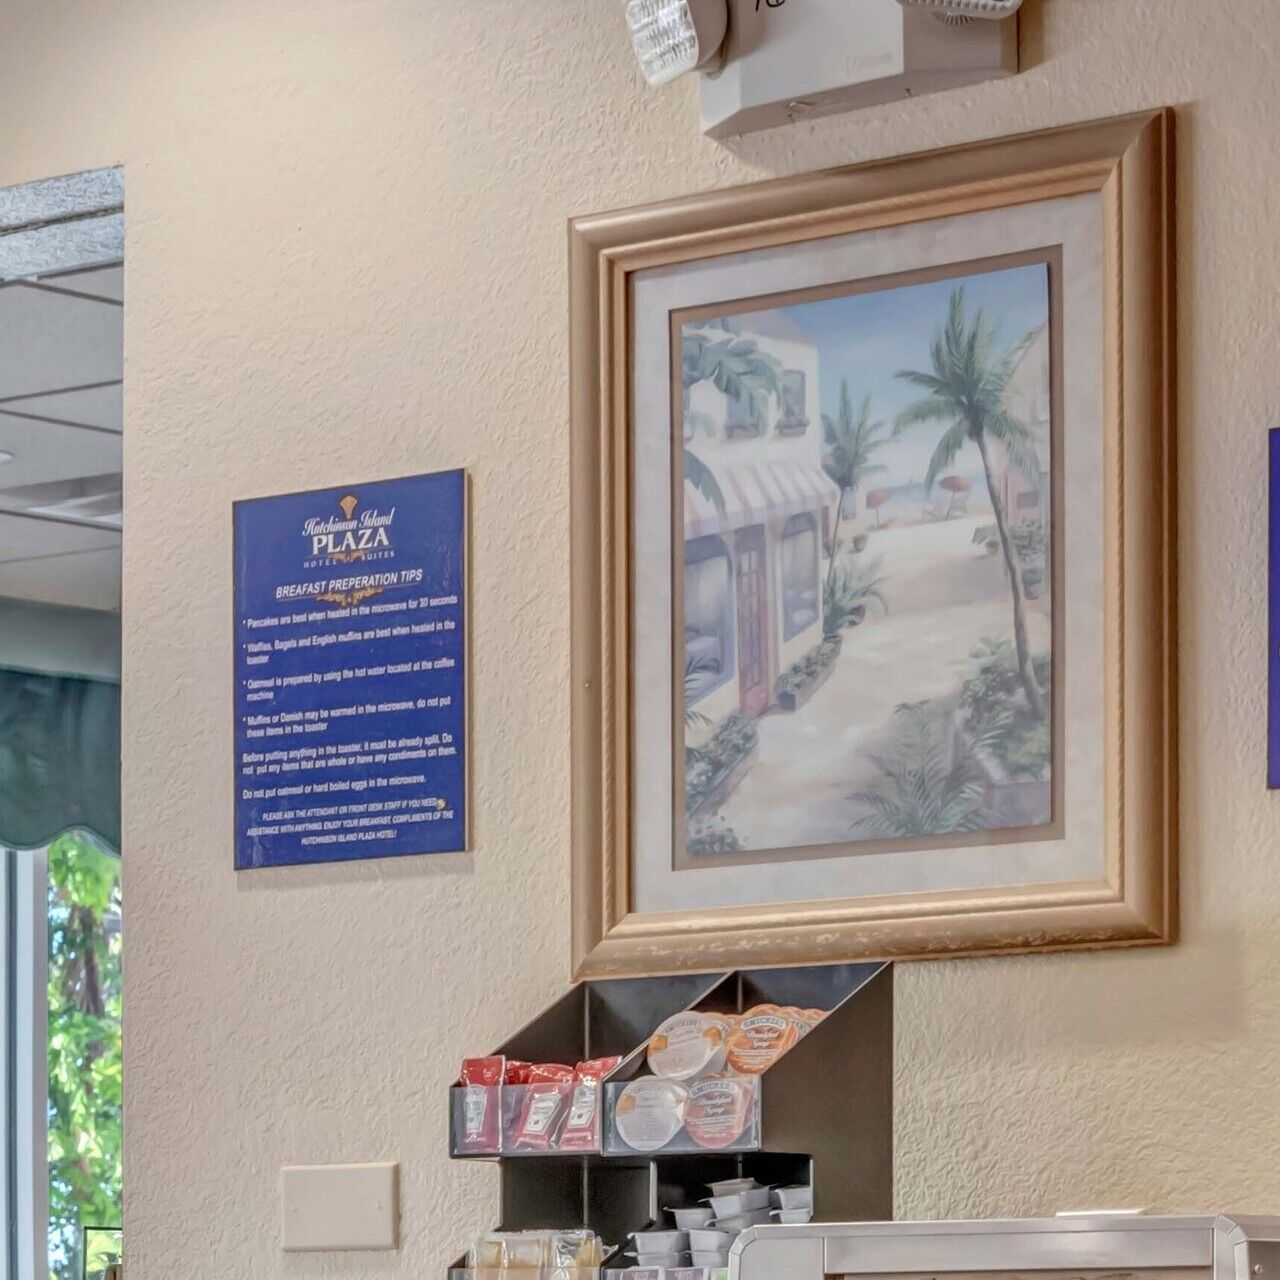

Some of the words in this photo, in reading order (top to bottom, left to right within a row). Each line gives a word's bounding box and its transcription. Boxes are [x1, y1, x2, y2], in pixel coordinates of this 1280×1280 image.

[302, 515, 357, 536] Hutchinson
[359, 506, 396, 527] Island
[313, 527, 388, 554] PLAZA
[276, 581, 326, 598] BREAFAST
[329, 573, 398, 590] PREPERATION
[401, 569, 423, 582] TIPS
